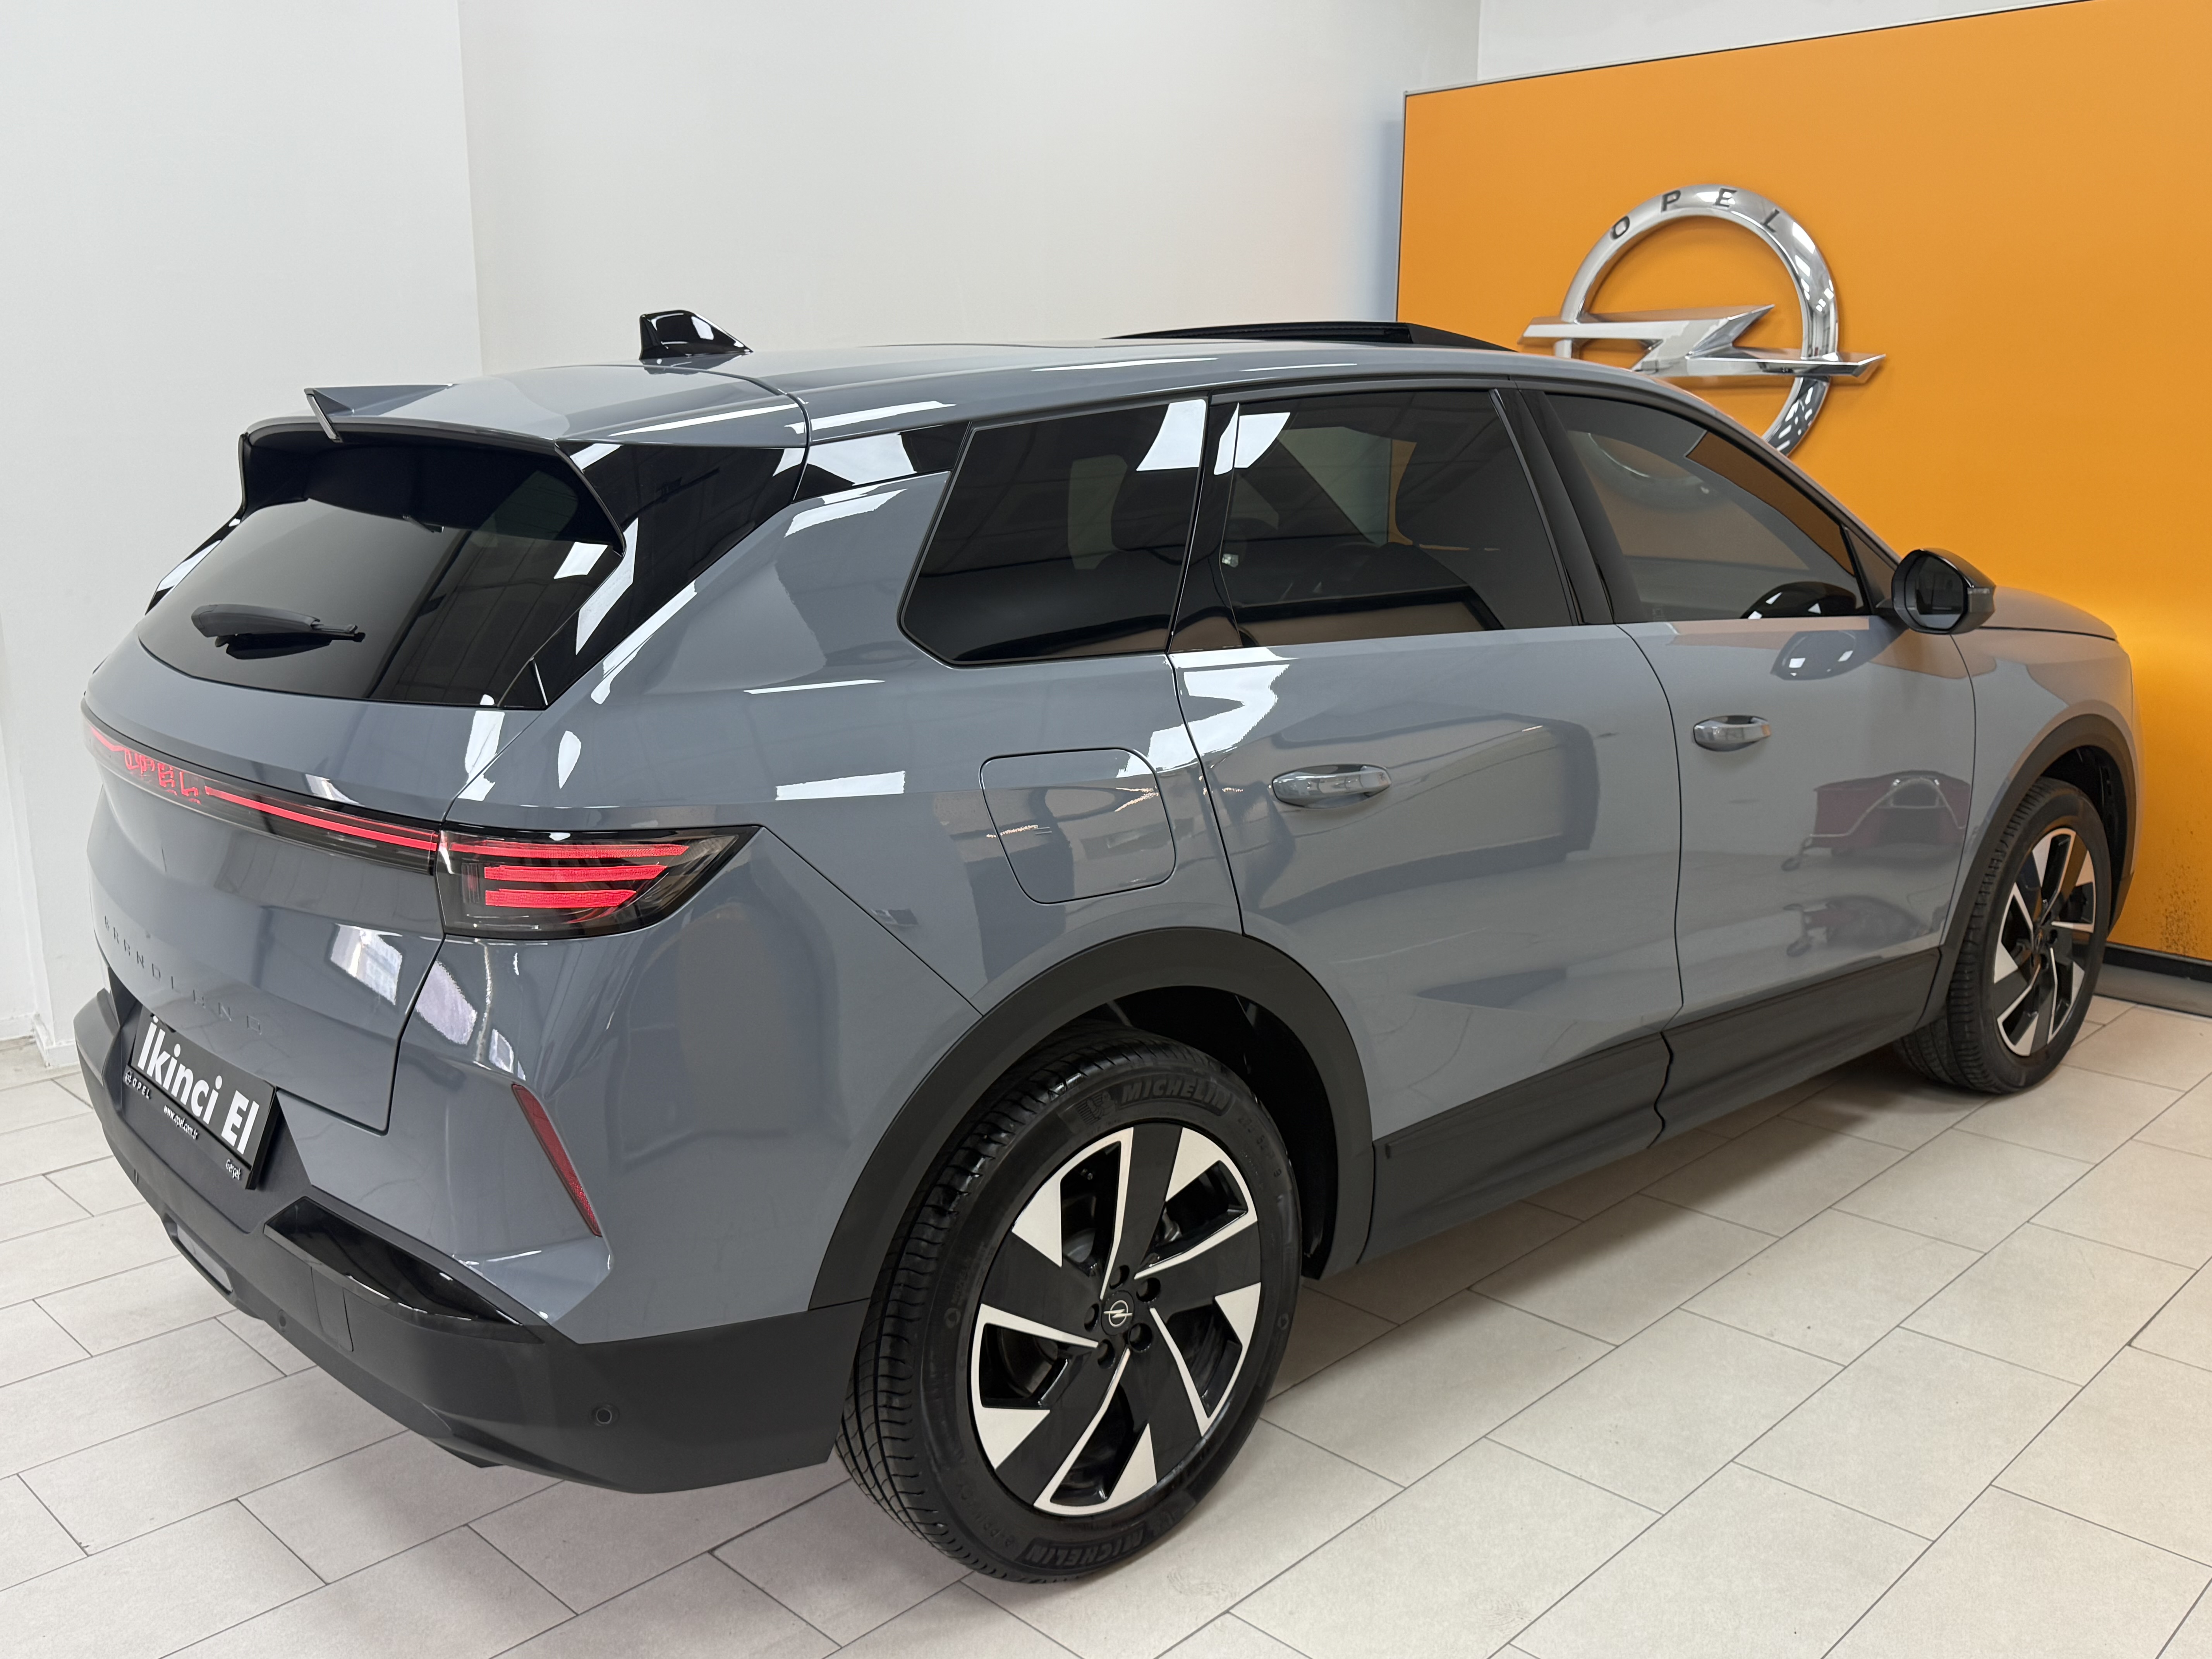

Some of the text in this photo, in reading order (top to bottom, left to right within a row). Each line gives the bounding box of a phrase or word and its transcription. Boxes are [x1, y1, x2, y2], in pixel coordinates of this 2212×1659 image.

[1610, 188, 1780, 239] OPEL
[124, 749, 199, 797] OPEL
[132, 1078, 149, 1099] OPEL
[1122, 1077, 1233, 1110] MICHELIN
[164, 1105, 198, 1140] www.opel.com.tr
[221, 1090, 259, 1154] El
[1024, 1528, 1144, 1566] MICHELIN
